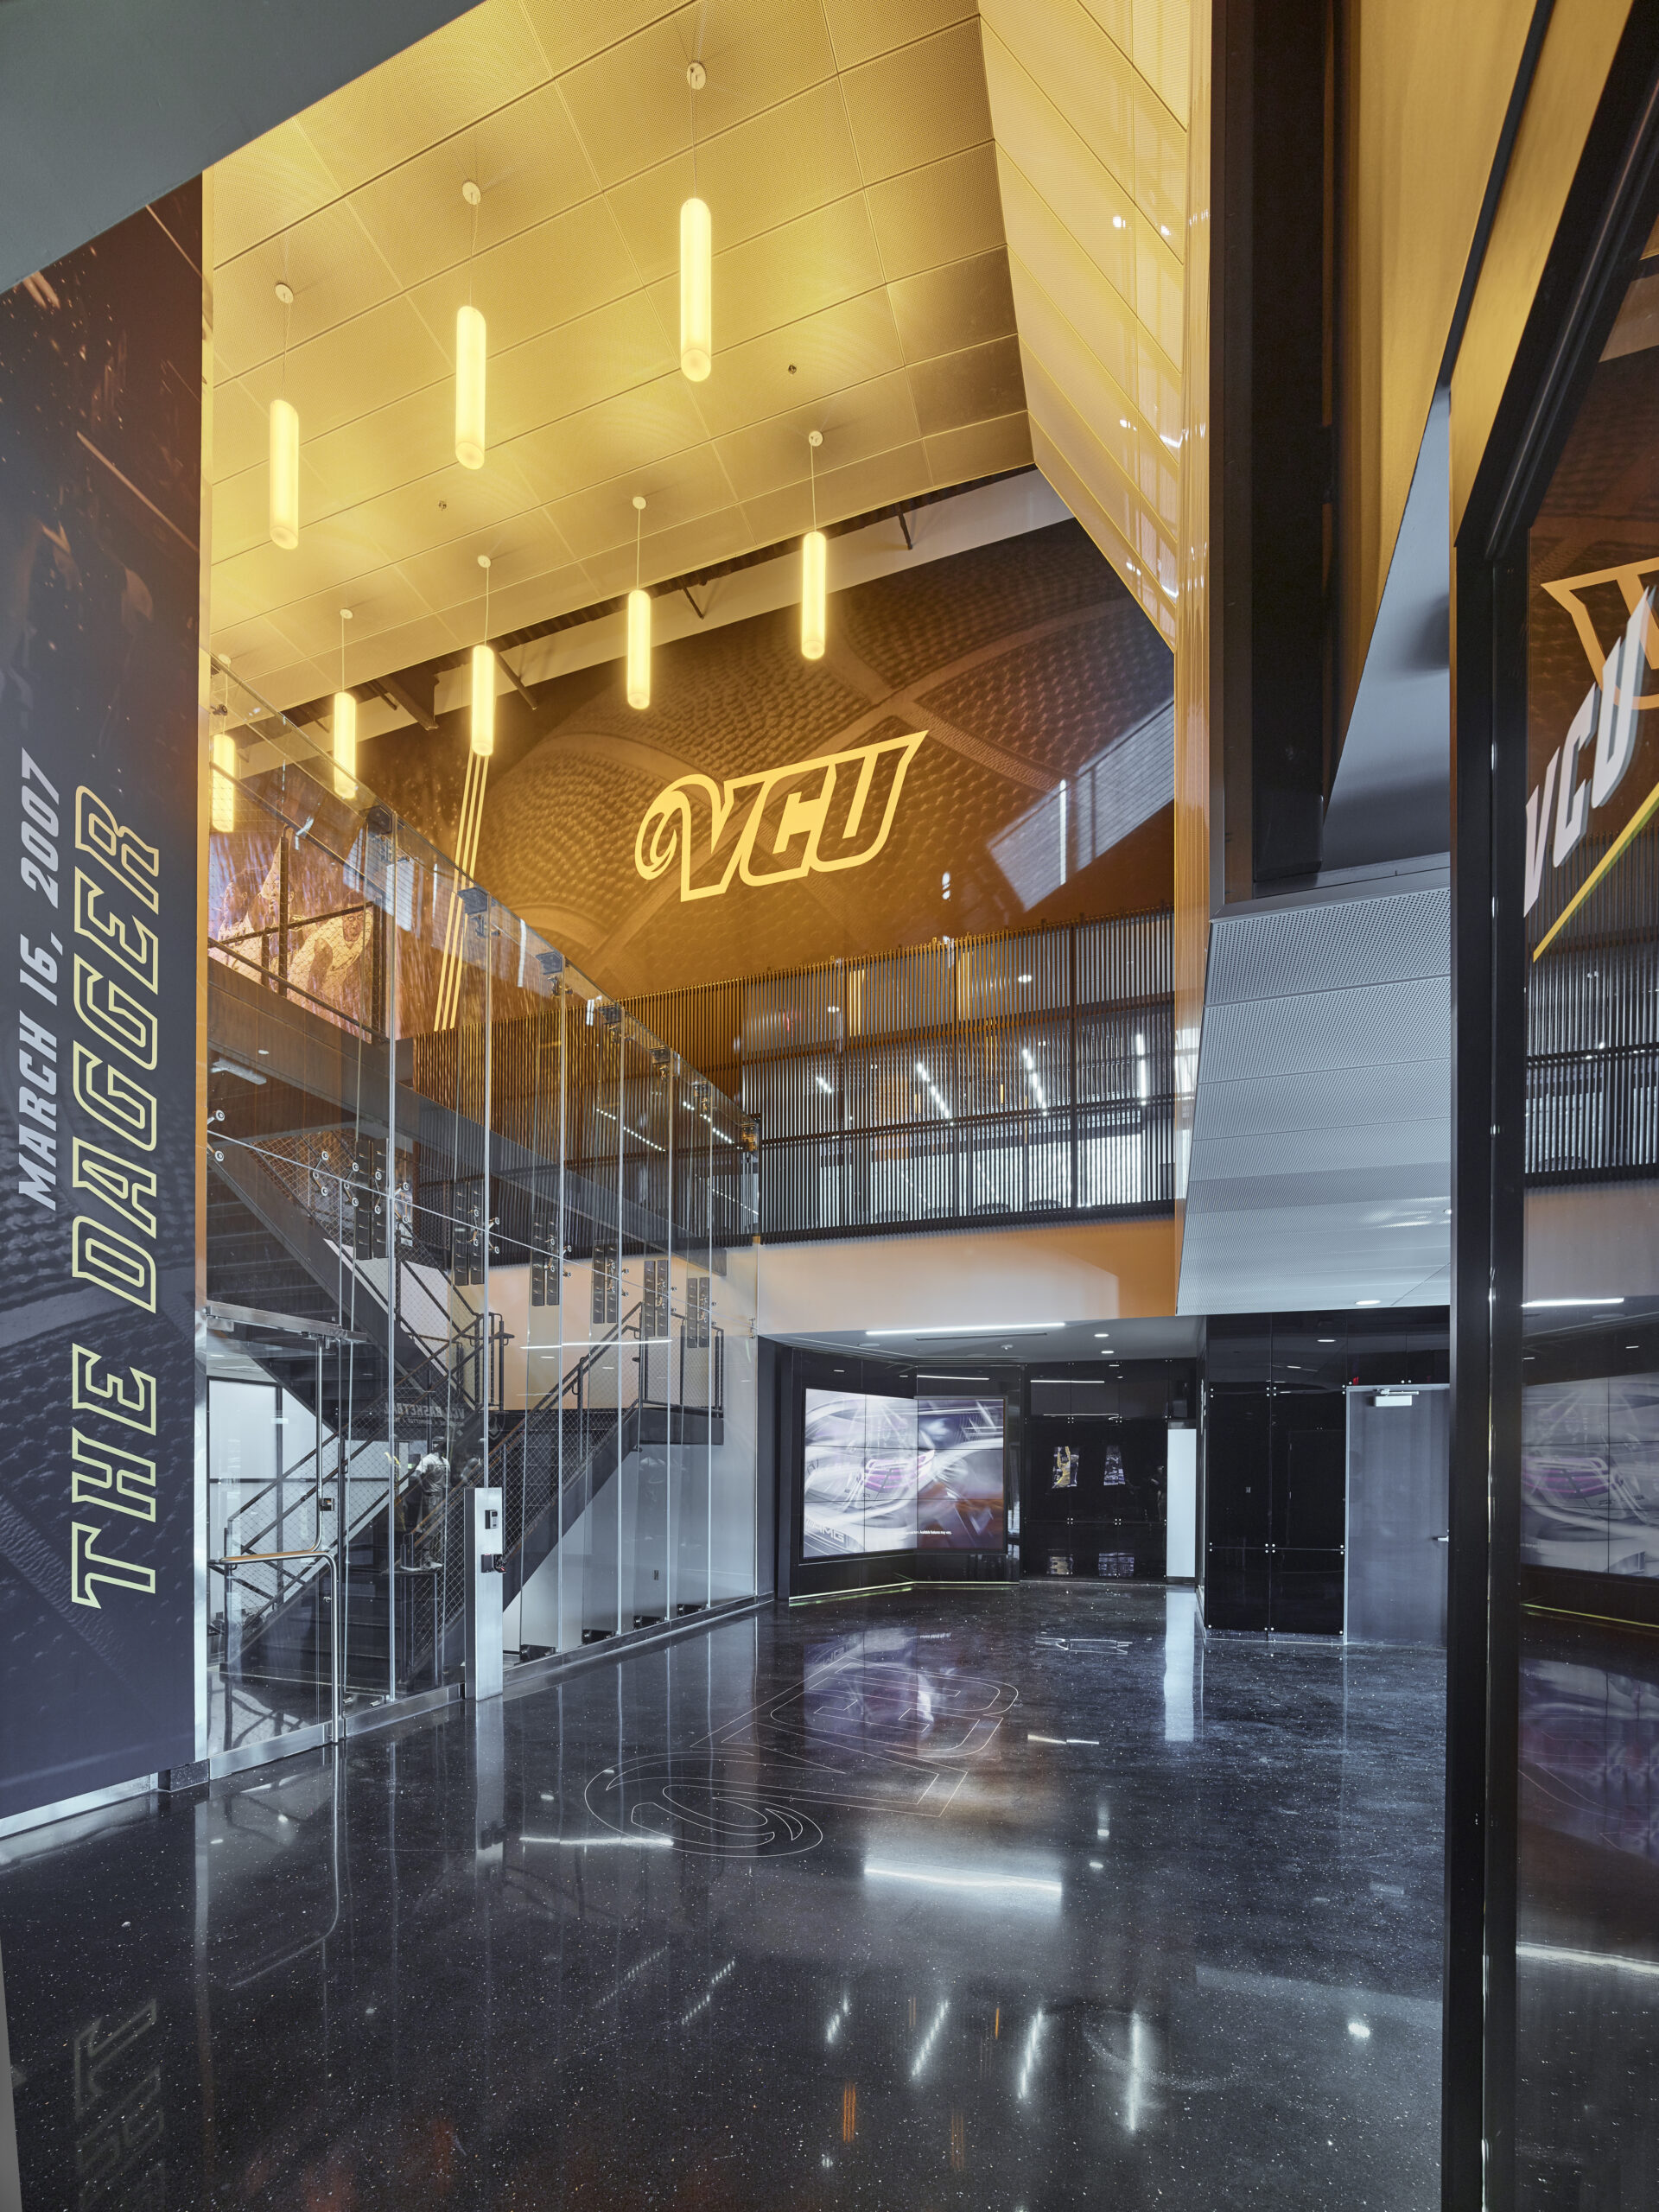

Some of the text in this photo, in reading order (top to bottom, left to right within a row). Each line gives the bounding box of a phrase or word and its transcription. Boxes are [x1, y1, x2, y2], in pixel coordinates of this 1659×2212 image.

[634, 730, 929, 902] VCU
[1523, 585, 1649, 918] VCU
[18, 747, 64, 1211] MARCH 16, 2007
[72, 785, 159, 1609] THE DAGGER
